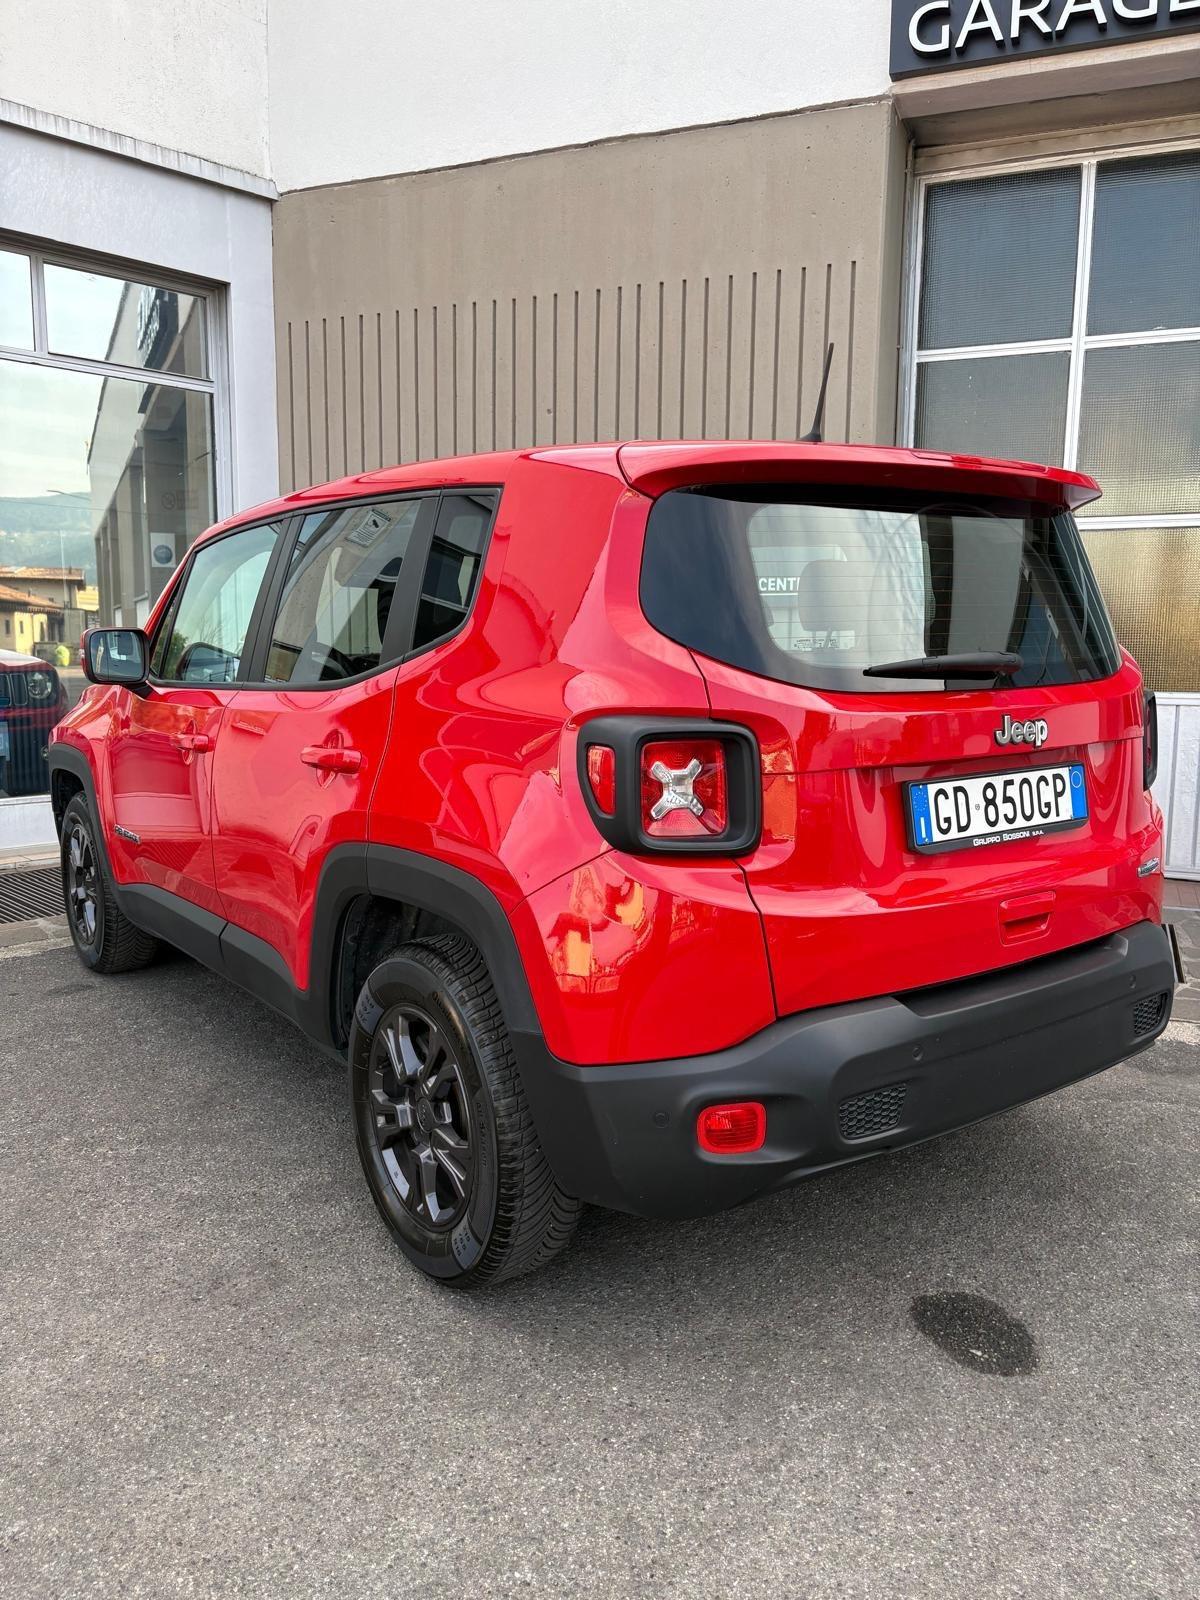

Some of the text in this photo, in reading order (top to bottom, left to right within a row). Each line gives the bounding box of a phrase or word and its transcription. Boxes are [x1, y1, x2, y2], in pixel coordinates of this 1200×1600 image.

[908, 0, 1200, 52] GARA
[995, 714, 1048, 747] Jeep
[933, 785, 971, 835] GD
[982, 772, 1067, 828] 850GP
[972, 835, 1000, 846] GRUPPO
